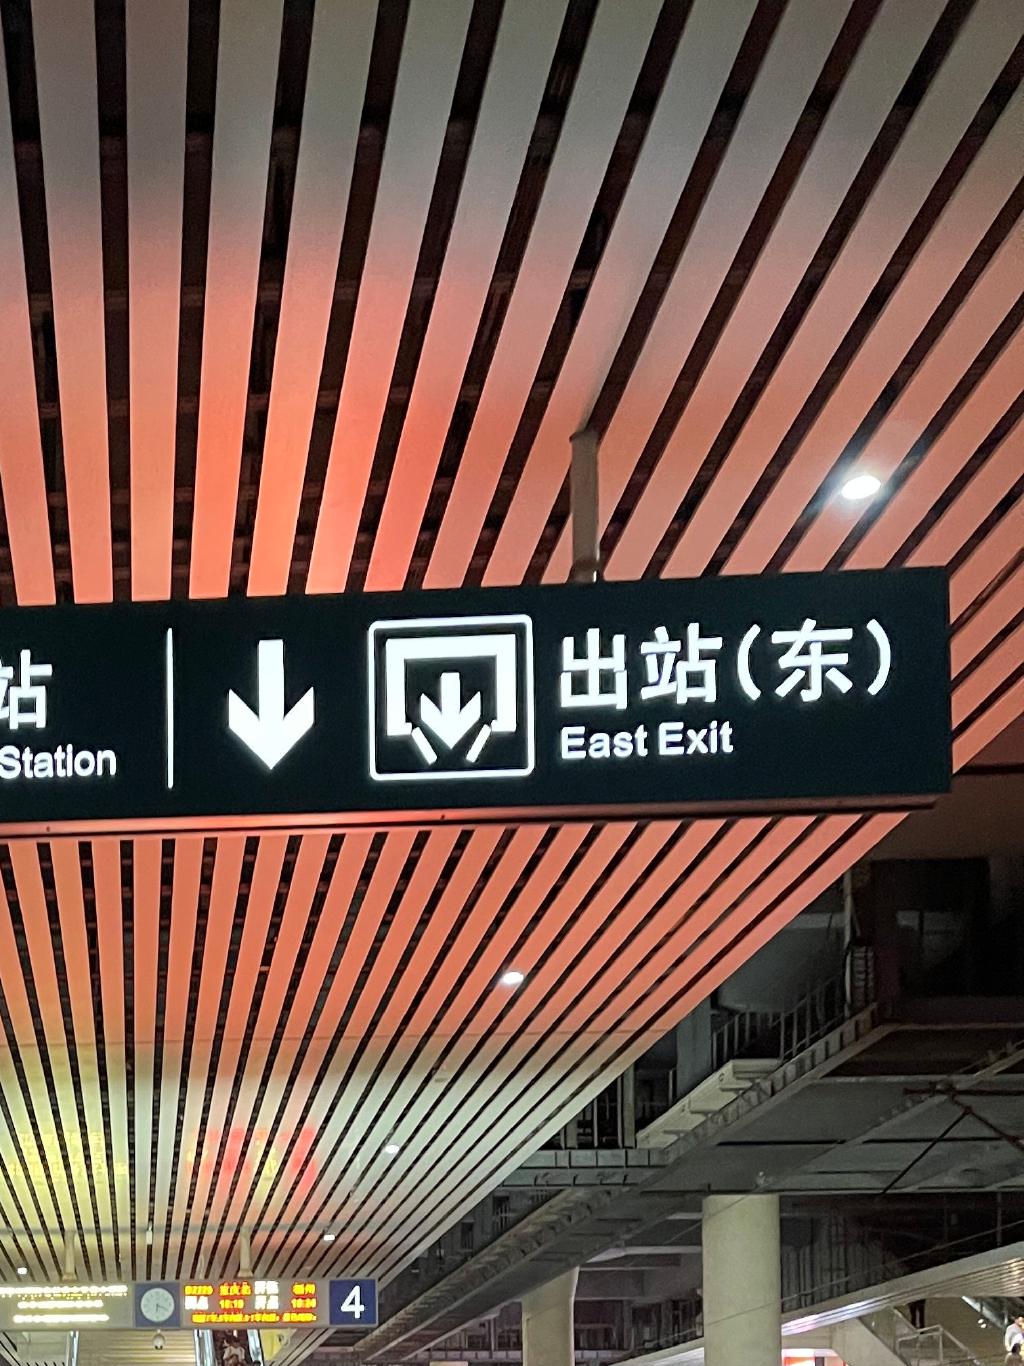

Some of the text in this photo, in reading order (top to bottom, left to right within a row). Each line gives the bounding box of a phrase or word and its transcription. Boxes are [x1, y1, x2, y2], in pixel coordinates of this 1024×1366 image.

[560, 618, 892, 710] 出站(东)
[560, 720, 734, 760] East Exit
[339, 1285, 365, 1319] 4
